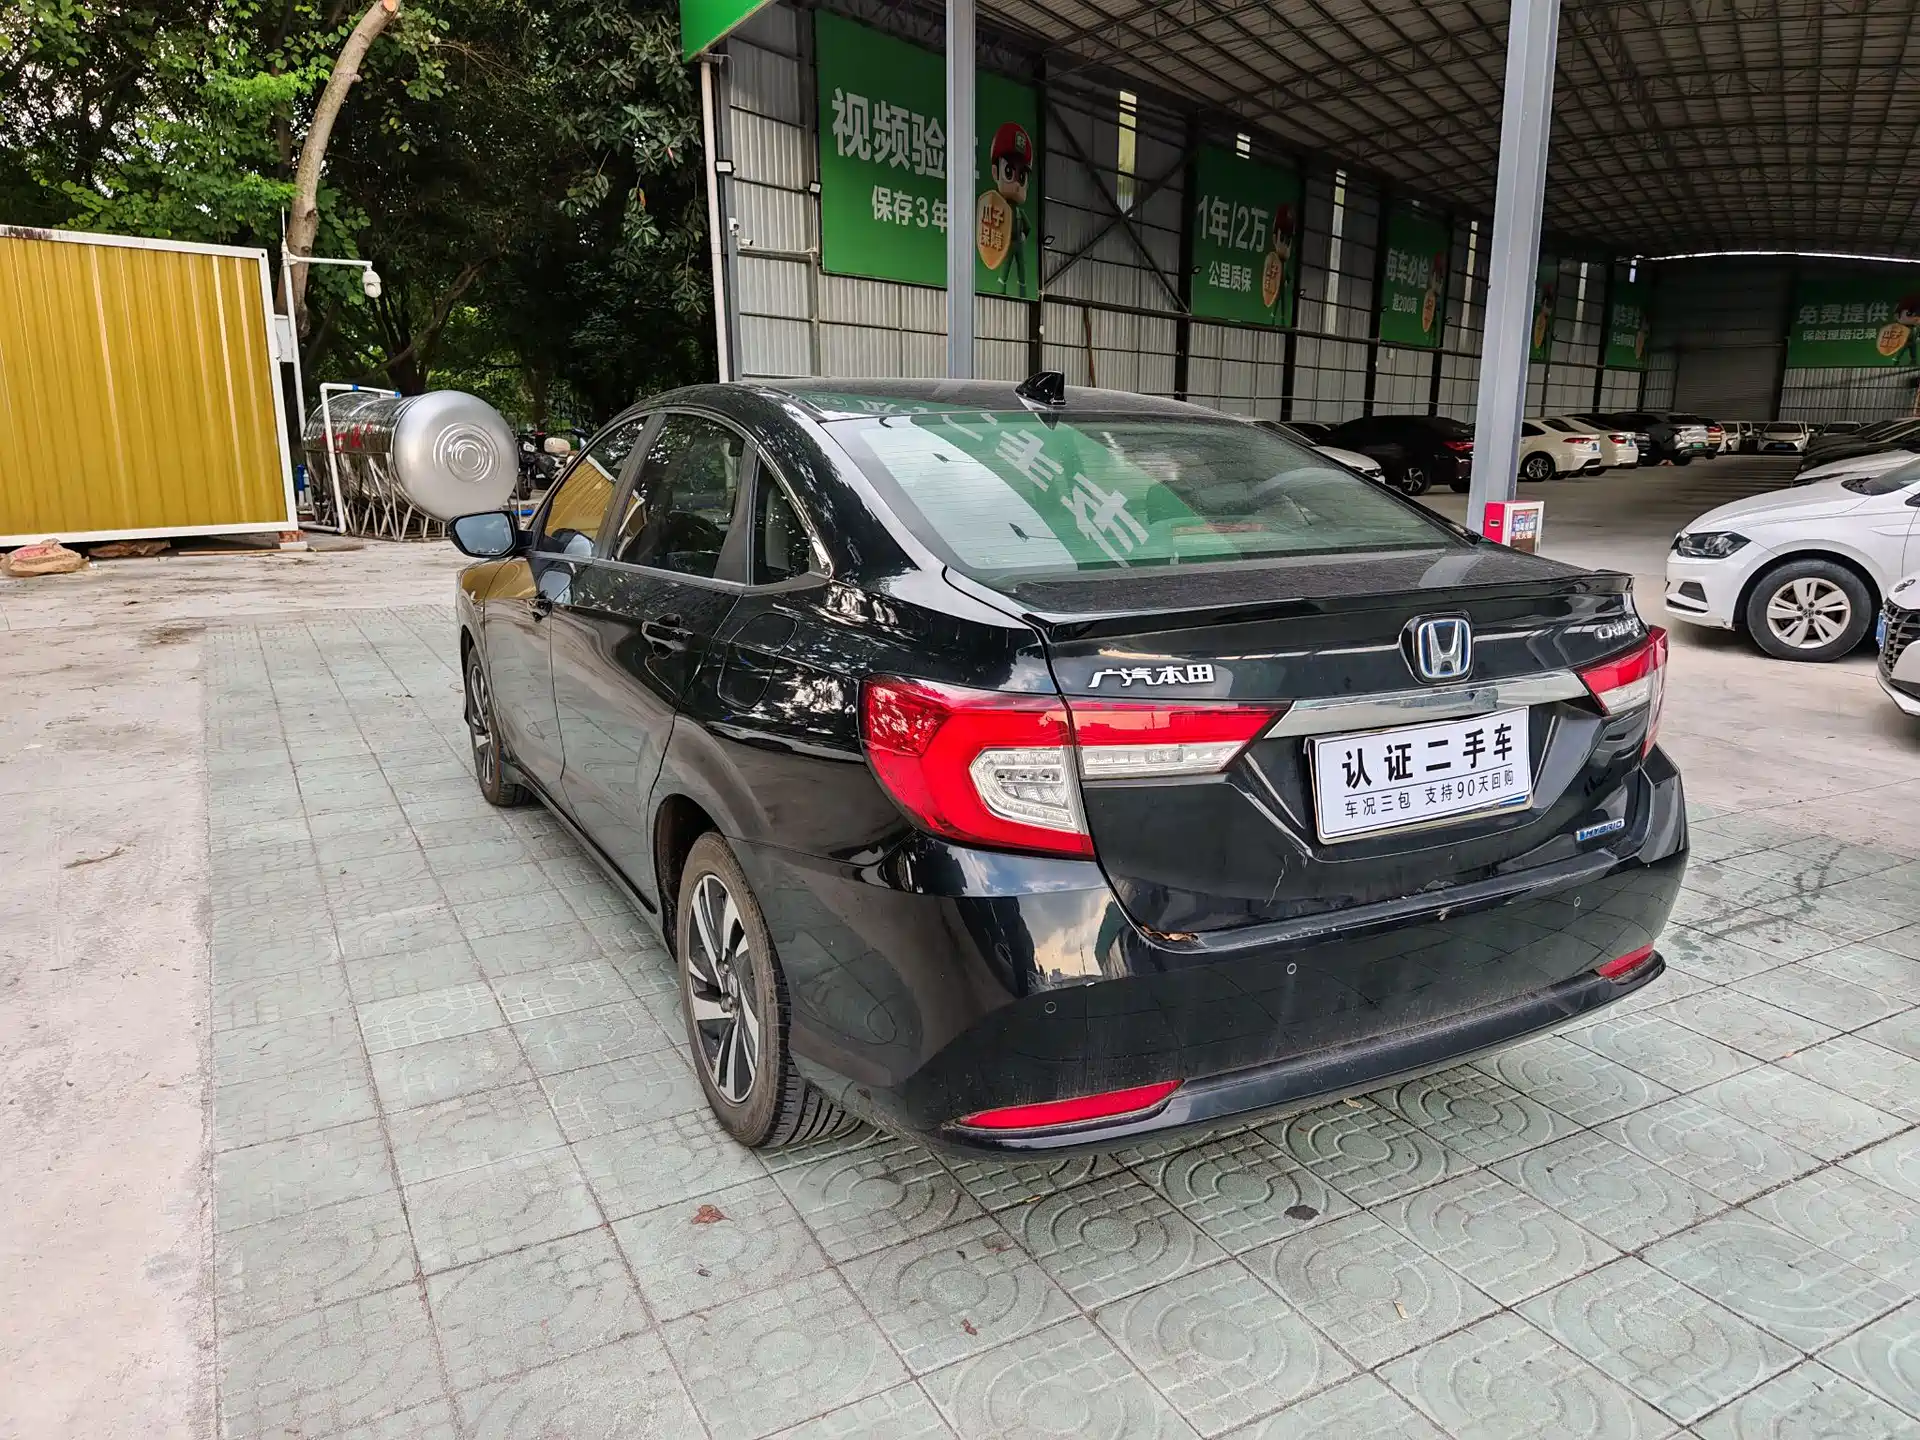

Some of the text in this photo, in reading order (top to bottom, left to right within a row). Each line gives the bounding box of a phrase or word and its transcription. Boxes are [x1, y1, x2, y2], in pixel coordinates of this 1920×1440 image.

[832, 87, 979, 180] 视频验
[871, 185, 947, 233] 保存3年
[1198, 195, 1268, 252] 1年/2万
[1208, 260, 1252, 292] 公里质保
[1796, 299, 1890, 325] 免费提供
[1088, 664, 1214, 688] 广汽本田
[1342, 723, 1512, 789] 认证二手车
[1345, 769, 1514, 819] 车况三包 支持90天回购
[1585, 819, 1623, 838] HYBRID
